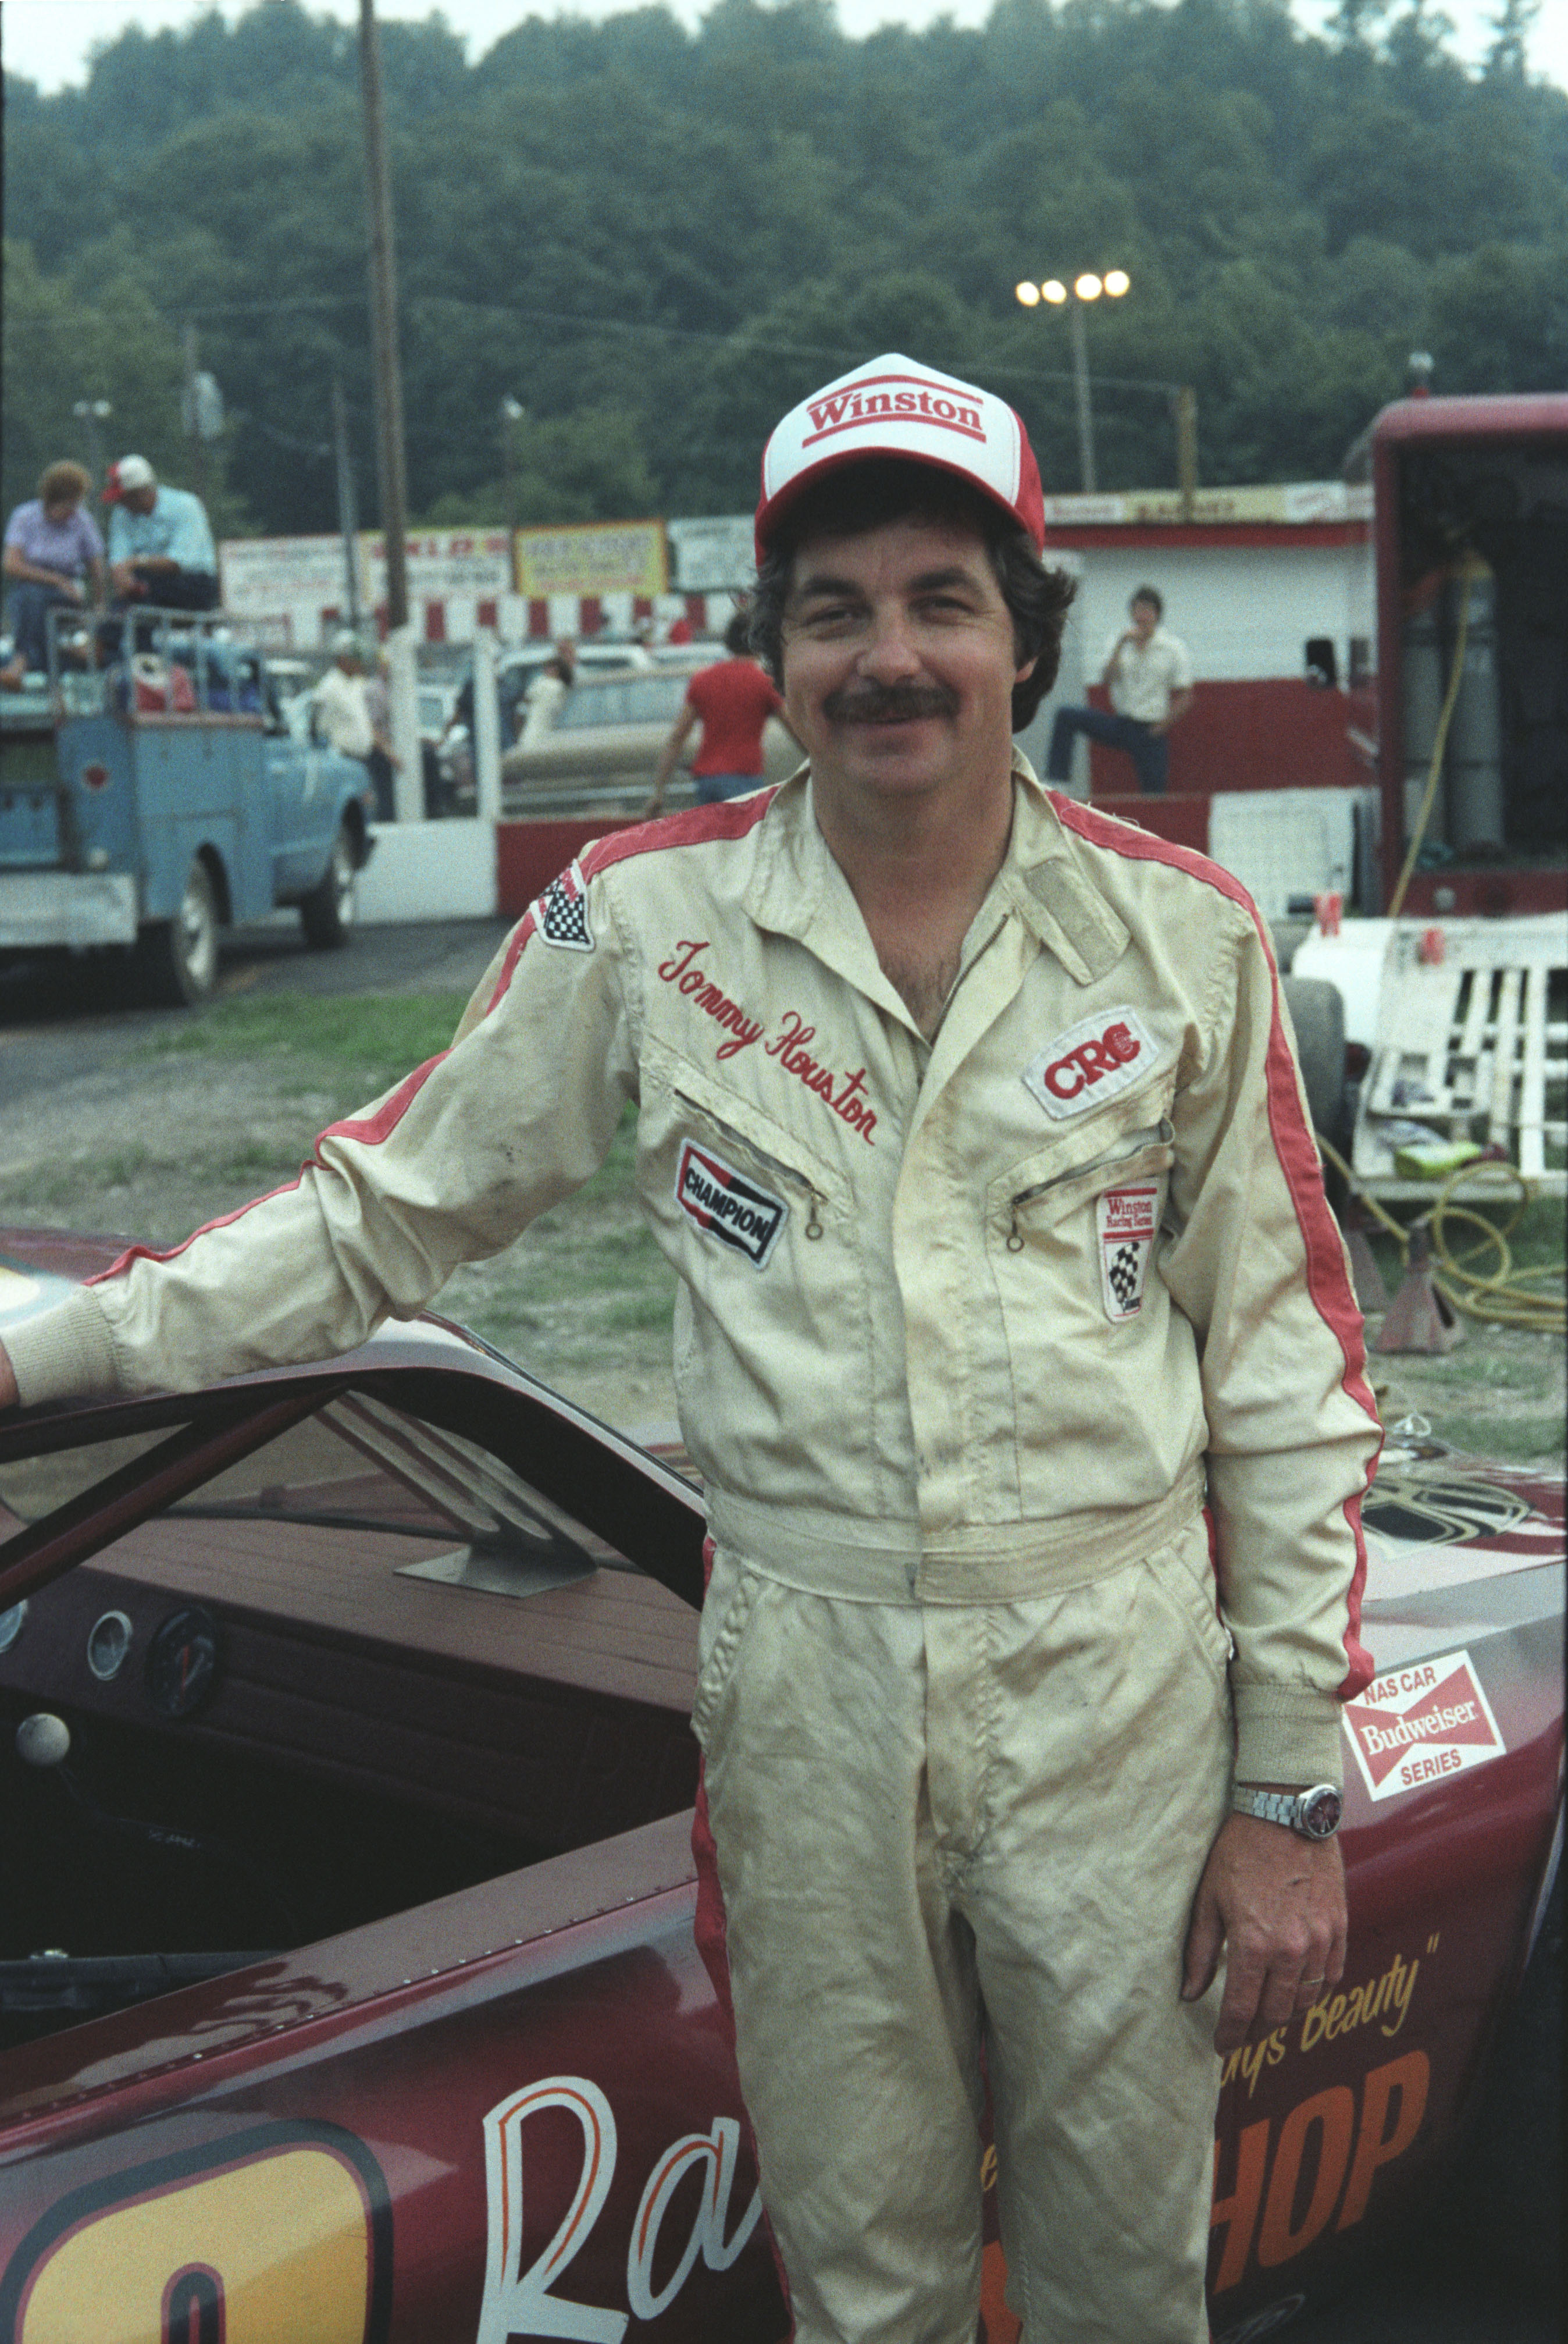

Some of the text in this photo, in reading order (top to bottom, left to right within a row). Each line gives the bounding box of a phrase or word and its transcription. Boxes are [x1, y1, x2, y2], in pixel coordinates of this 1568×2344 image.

[808, 391, 983, 431] Winston
[658, 940, 878, 1146] Tommy Houston
[1044, 1021, 1141, 1100] CRC
[685, 1167, 771, 1242] CHAMPION
[1107, 1198, 1152, 1217] Winston
[1360, 1700, 1477, 1755] Budweiser
[1400, 1748, 1462, 1786] SERIES
